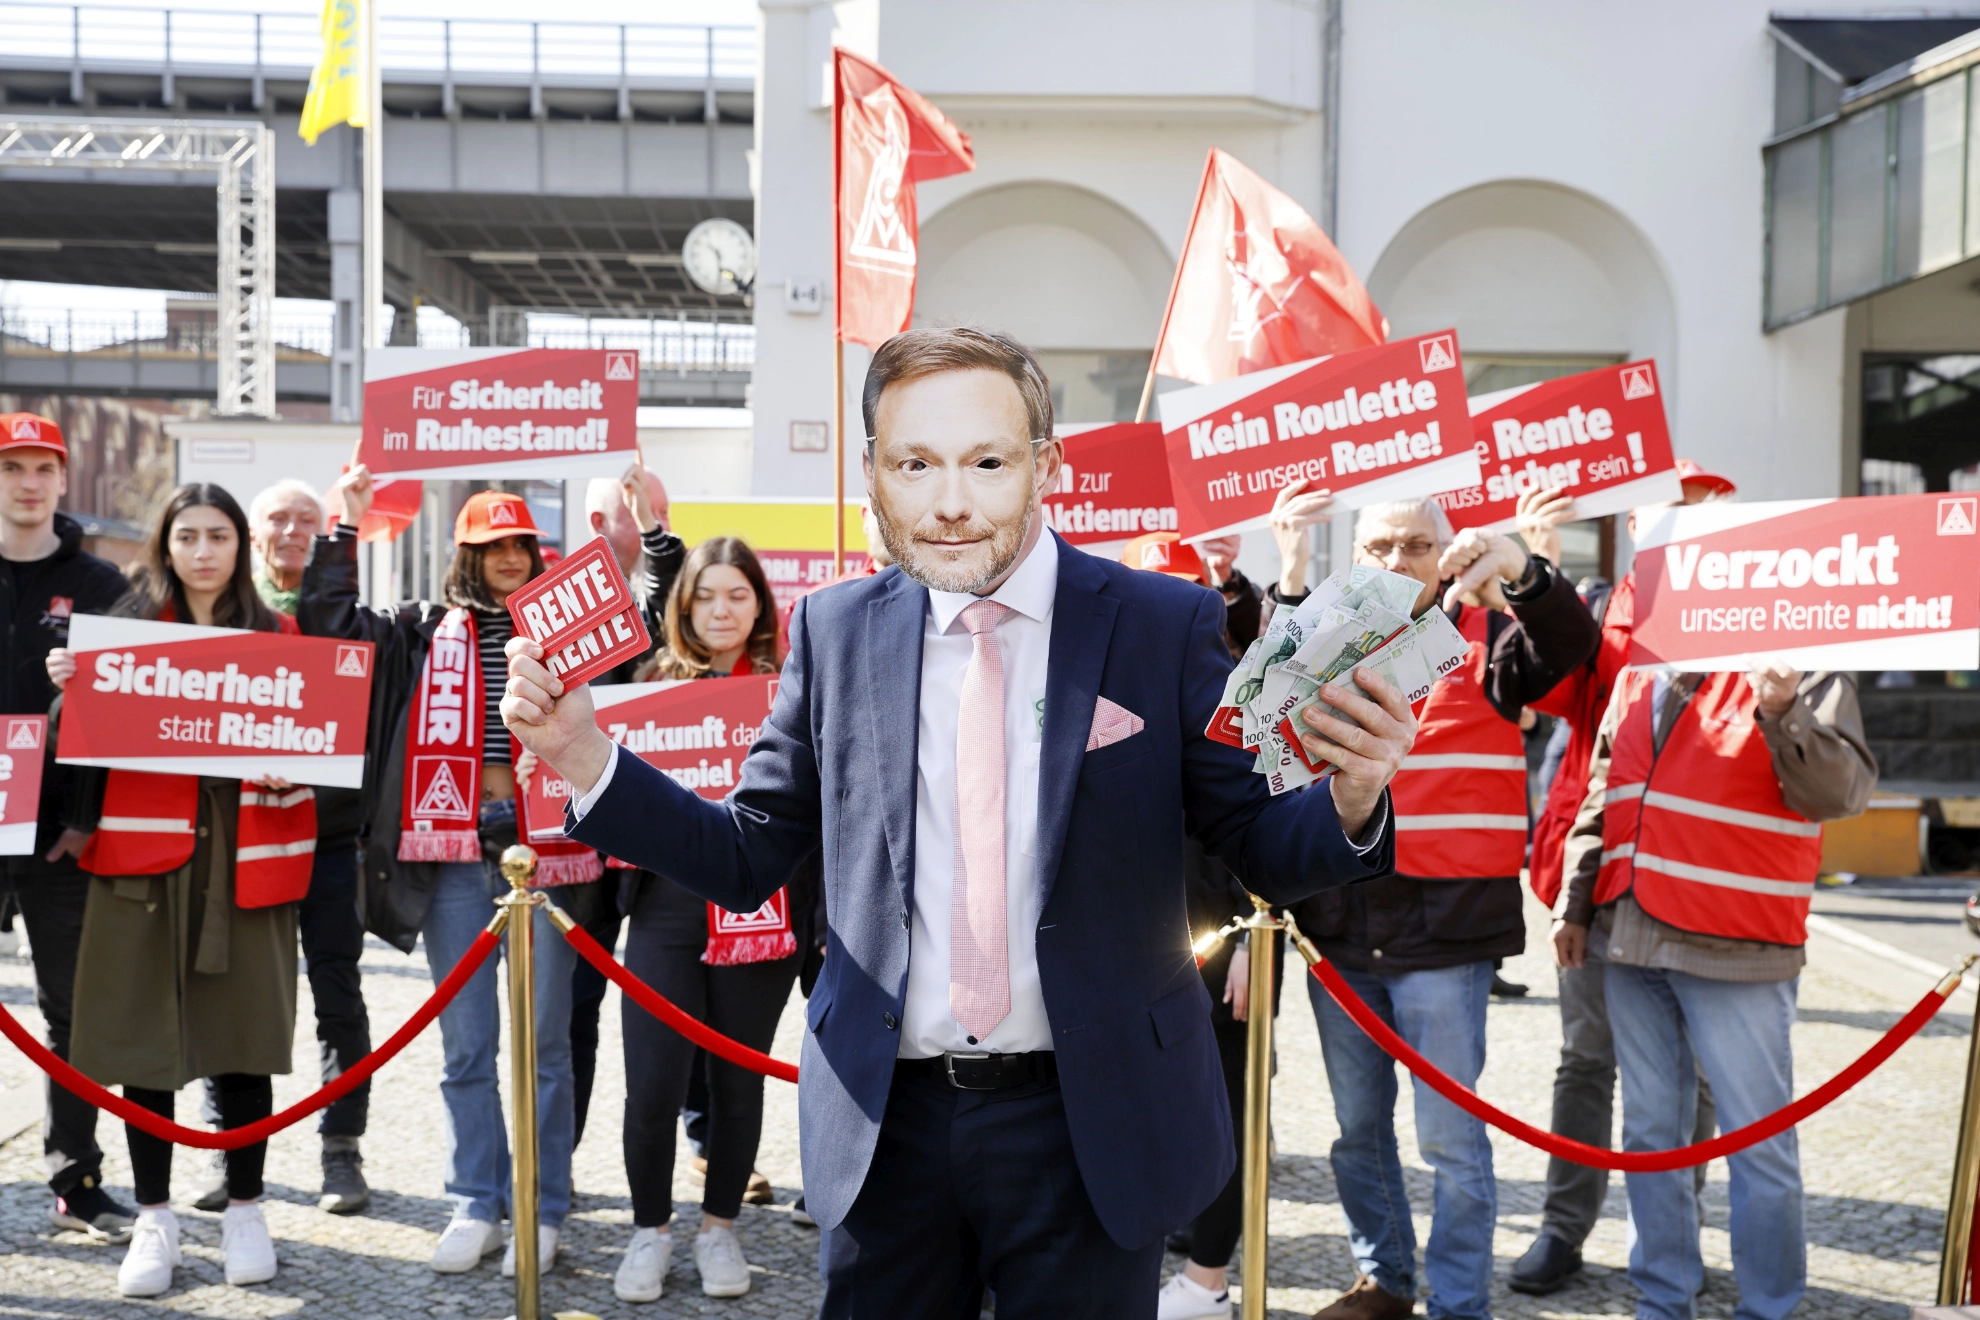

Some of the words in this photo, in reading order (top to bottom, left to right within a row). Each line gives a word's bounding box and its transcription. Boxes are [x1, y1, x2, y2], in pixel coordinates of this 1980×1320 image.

[413, 385, 445, 410] Für
[449, 378, 604, 410] Sicherheit
[383, 428, 409, 451] im
[415, 418, 609, 452] Ruhestand!
[1187, 410, 1271, 461] Kein
[1273, 377, 1439, 442] Roulette
[1492, 404, 1615, 461] Rente
[1207, 470, 1245, 502] mit
[1246, 455, 1328, 491] unserer
[1331, 420, 1444, 476] Rente!
[1079, 472, 1113, 493] zur
[1486, 459, 1582, 502] sicher
[1042, 500, 1179, 533] Aktienren
[1665, 533, 1900, 591] Verzockt
[522, 558, 616, 644] RENTE
[1680, 606, 1767, 633] unsere
[1773, 599, 1851, 631] Rente
[1856, 595, 1953, 630] nicht!
[1284, 618, 1301, 637] 100
[92, 652, 305, 710] Sicherheit
[1436, 655, 1460, 674] 100
[1278, 695, 1299, 716] 100
[1407, 684, 1430, 702] 100
[158, 715, 215, 744] statt
[217, 711, 338, 755] Risiko!
[608, 715, 727, 754] Zukunft
[731, 722, 762, 747] dar
[1245, 731, 1264, 745] 100
[1270, 771, 1285, 792] 100
